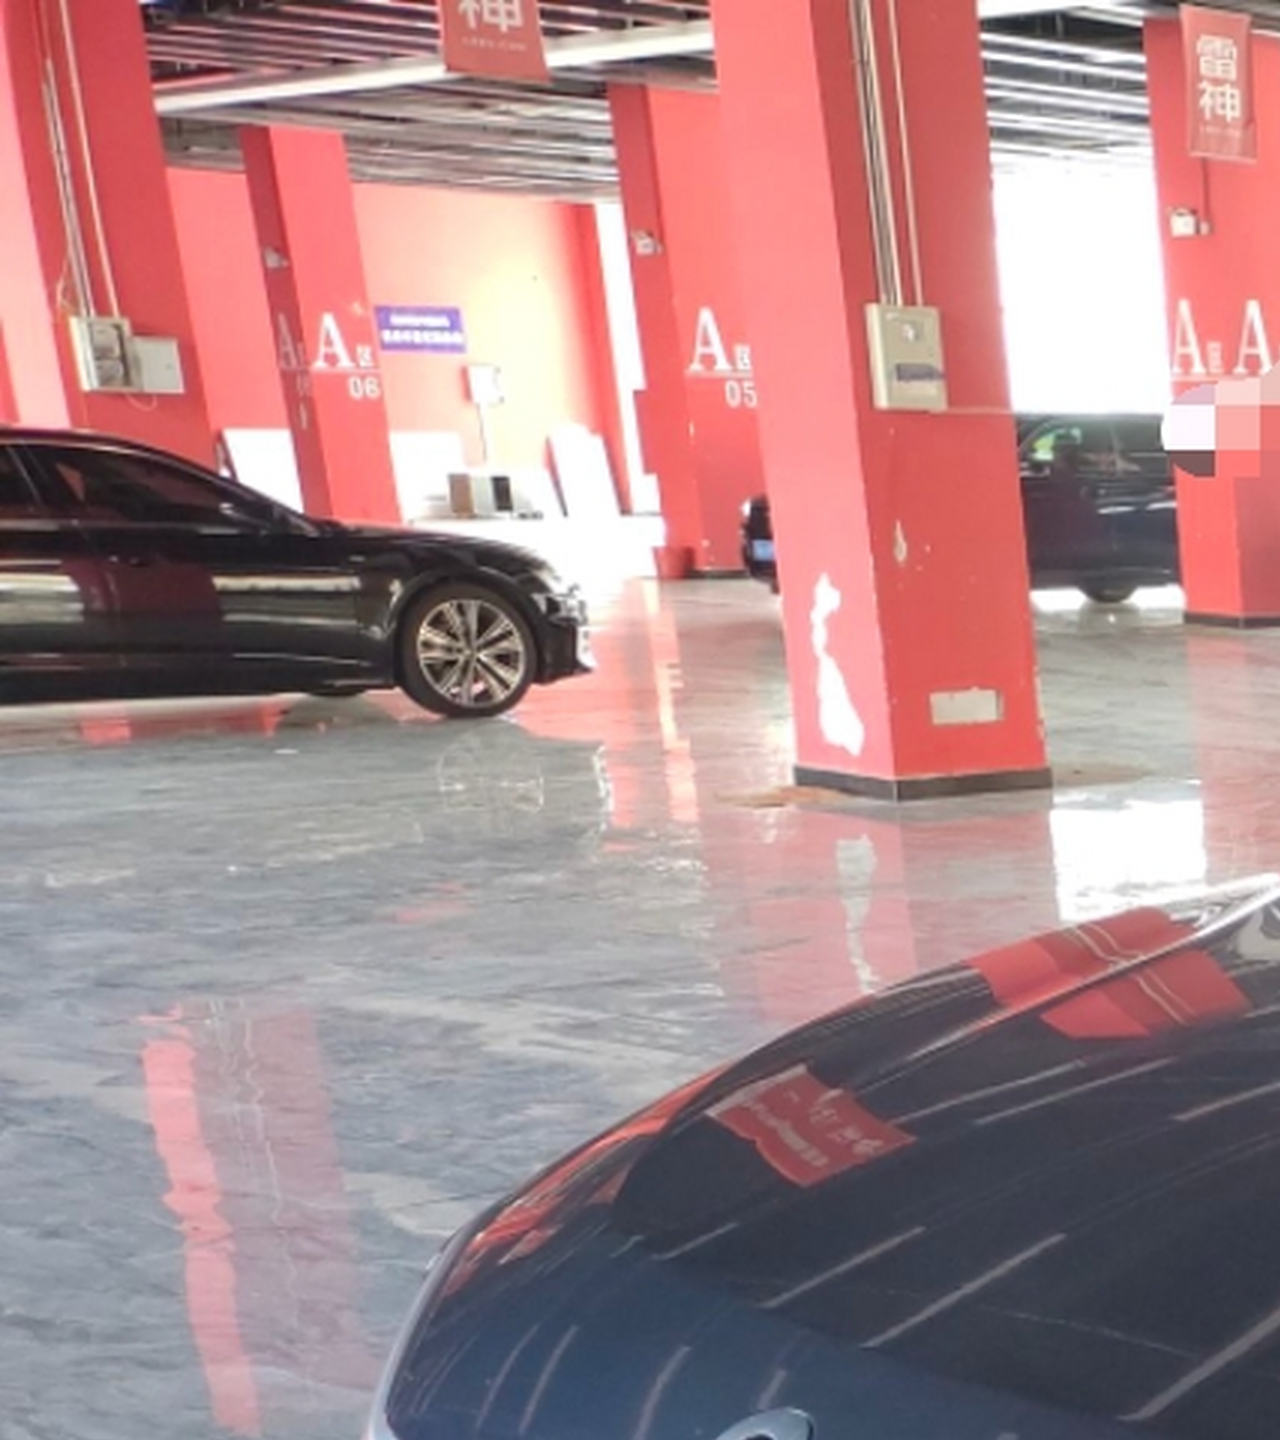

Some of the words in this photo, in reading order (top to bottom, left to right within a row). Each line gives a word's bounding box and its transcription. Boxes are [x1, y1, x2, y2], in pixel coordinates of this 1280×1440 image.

[1196, 33, 1241, 123] 雷神
[312, 312, 374, 368] A区
[688, 305, 751, 371] A区
[349, 377, 381, 400] 06
[725, 381, 758, 408] 05
